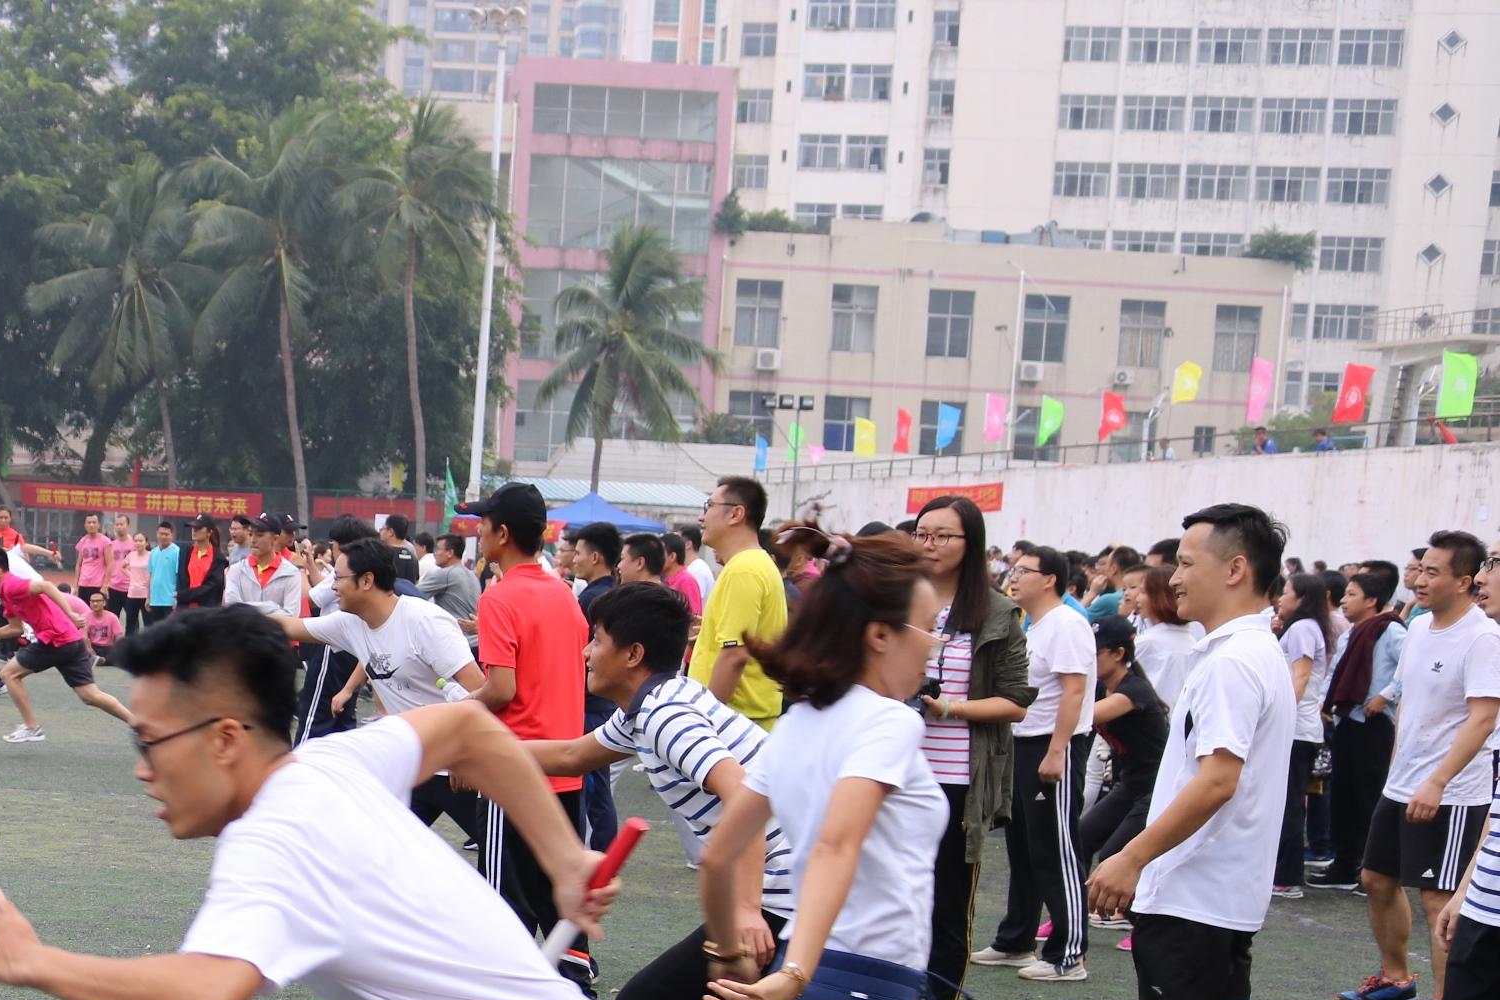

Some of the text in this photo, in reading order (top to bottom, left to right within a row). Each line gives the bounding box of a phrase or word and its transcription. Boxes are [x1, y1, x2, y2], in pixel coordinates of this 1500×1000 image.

[36, 487, 247, 514] 激情燃烧希望 拼搏赢得未来
